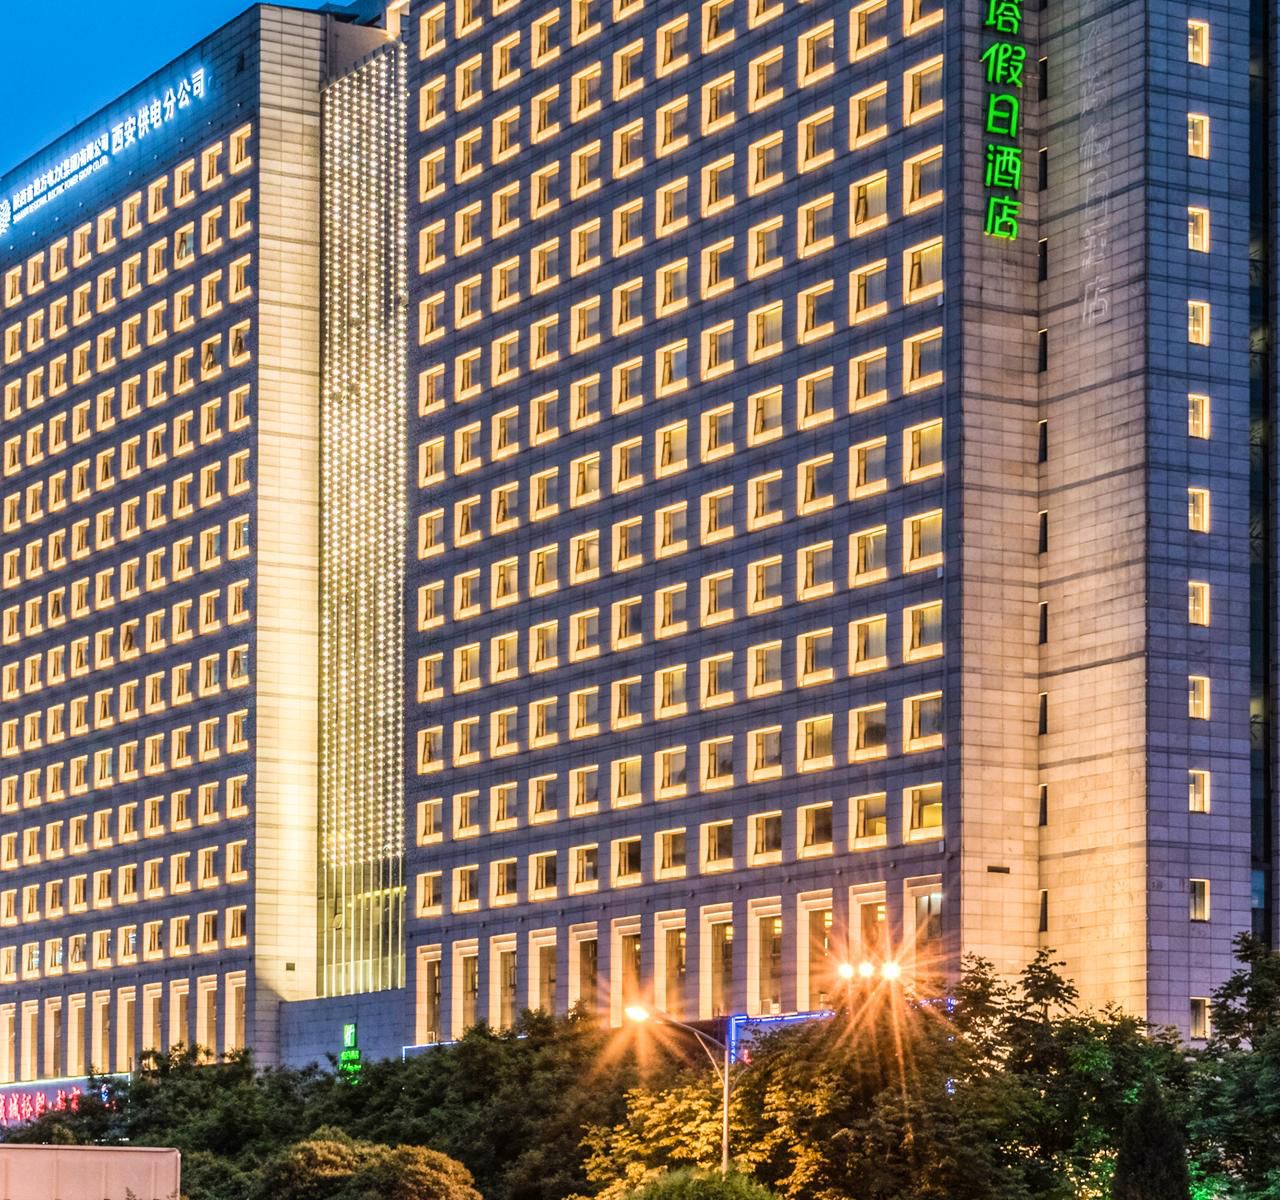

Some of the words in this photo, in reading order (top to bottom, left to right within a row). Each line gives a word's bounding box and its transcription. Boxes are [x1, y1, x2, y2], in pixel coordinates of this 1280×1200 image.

[112, 68, 204, 154] 西安供电分公司
